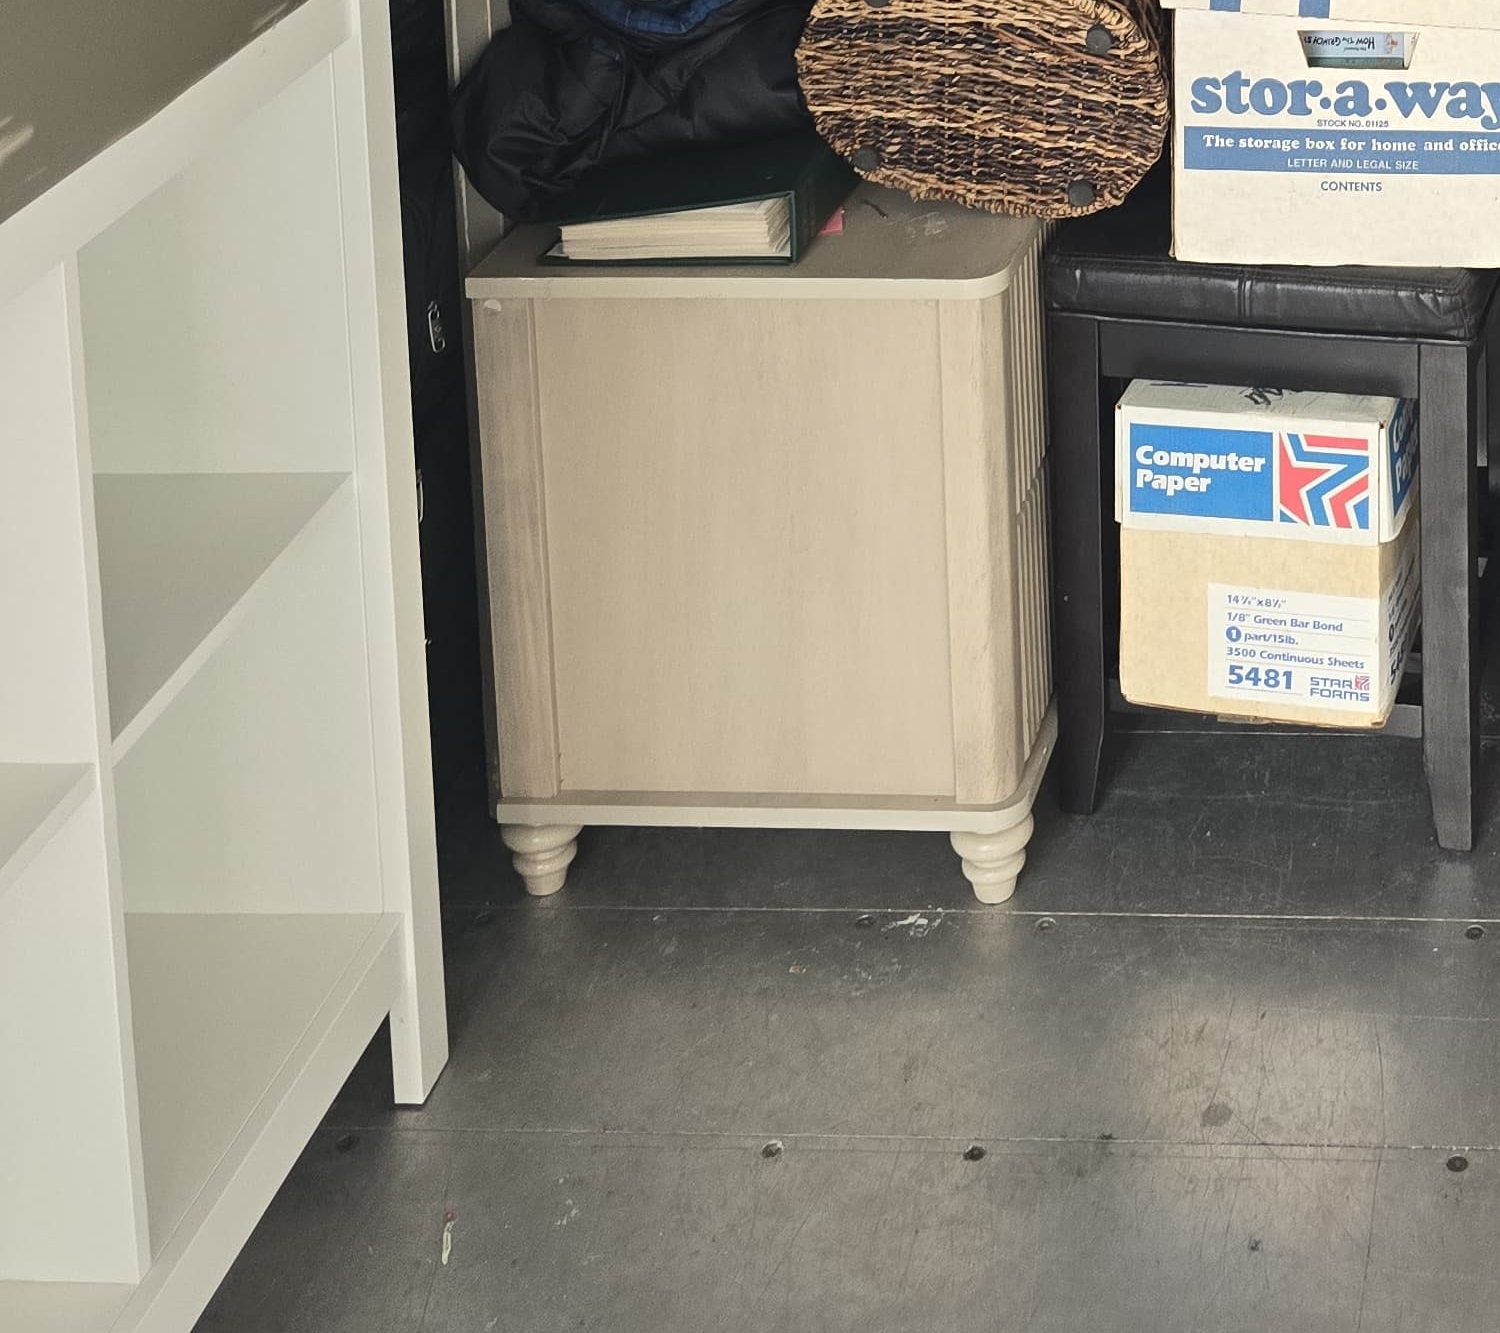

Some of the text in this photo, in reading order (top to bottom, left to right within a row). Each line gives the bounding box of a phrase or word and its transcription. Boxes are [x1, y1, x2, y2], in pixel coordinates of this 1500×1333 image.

[1317, 119, 1389, 128] STOCK NO. 01125
[1203, 134, 1235, 148] The
[1238, 137, 1300, 152] storage
[1305, 137, 1335, 150] box
[1340, 137, 1366, 151] for
[1371, 138, 1416, 152] home
[1423, 138, 1453, 152] and
[1287, 157, 1419, 171] LETTER AND LEGAL SIZE
[1320, 181, 1383, 192] CONTENTS
[1135, 445, 1266, 474] Computer
[1135, 468, 1211, 497] Paper
[1253, 615, 1287, 627] Green
[1290, 618, 1310, 629] Bar
[1313, 621, 1343, 632] Bond
[1226, 646, 1364, 669] 3500 Continuous Sheets
[1228, 664, 1293, 690] 5481
[1310, 676, 1353, 688] STAR
[1310, 687, 1370, 702] FORMS
